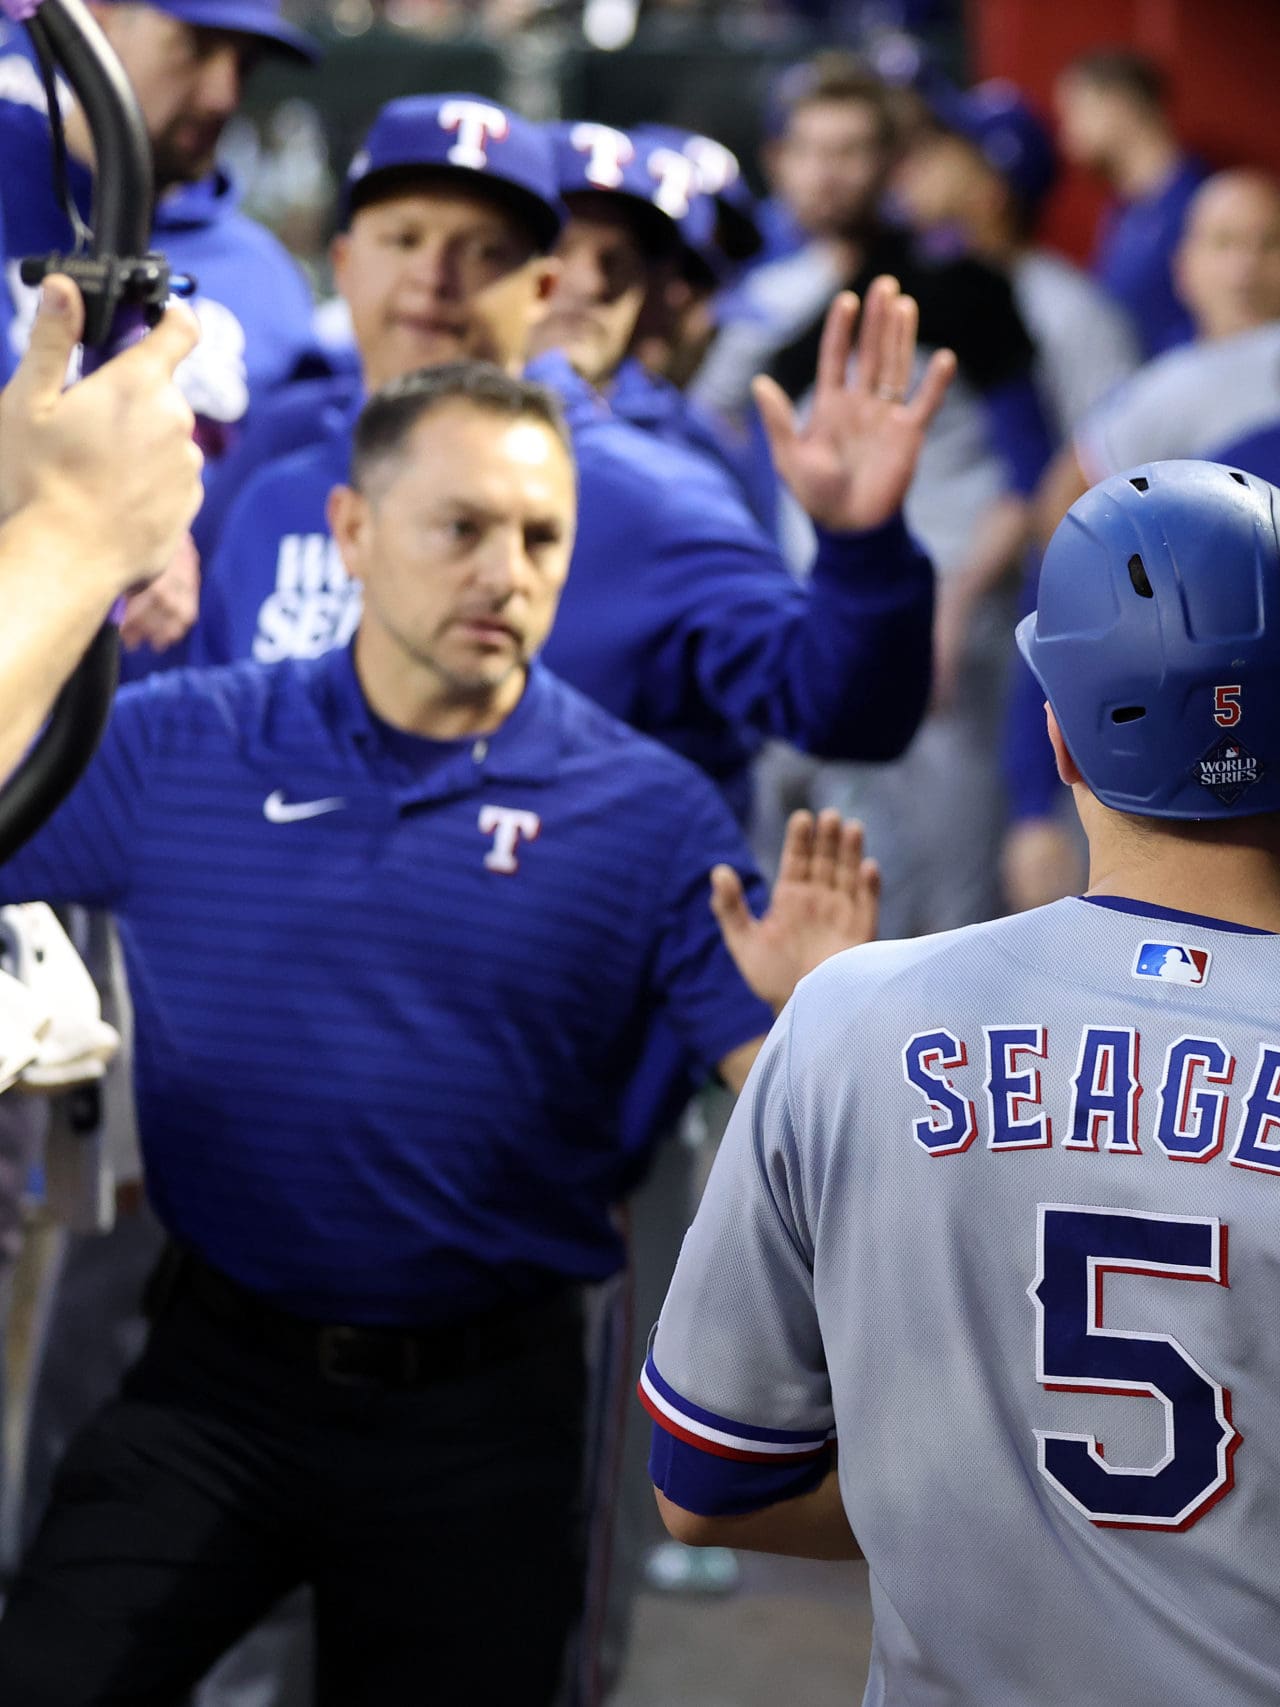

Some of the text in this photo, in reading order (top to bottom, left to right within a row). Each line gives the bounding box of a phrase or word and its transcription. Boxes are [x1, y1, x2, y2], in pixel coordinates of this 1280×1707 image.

[438, 100, 510, 170] T
[570, 127, 635, 190] T
[1214, 685, 1241, 727] 5
[1200, 758, 1257, 773] WORLD
[1201, 769, 1257, 785] SERIES
[478, 804, 542, 876] T
[1026, 1202, 1244, 1533] 5
